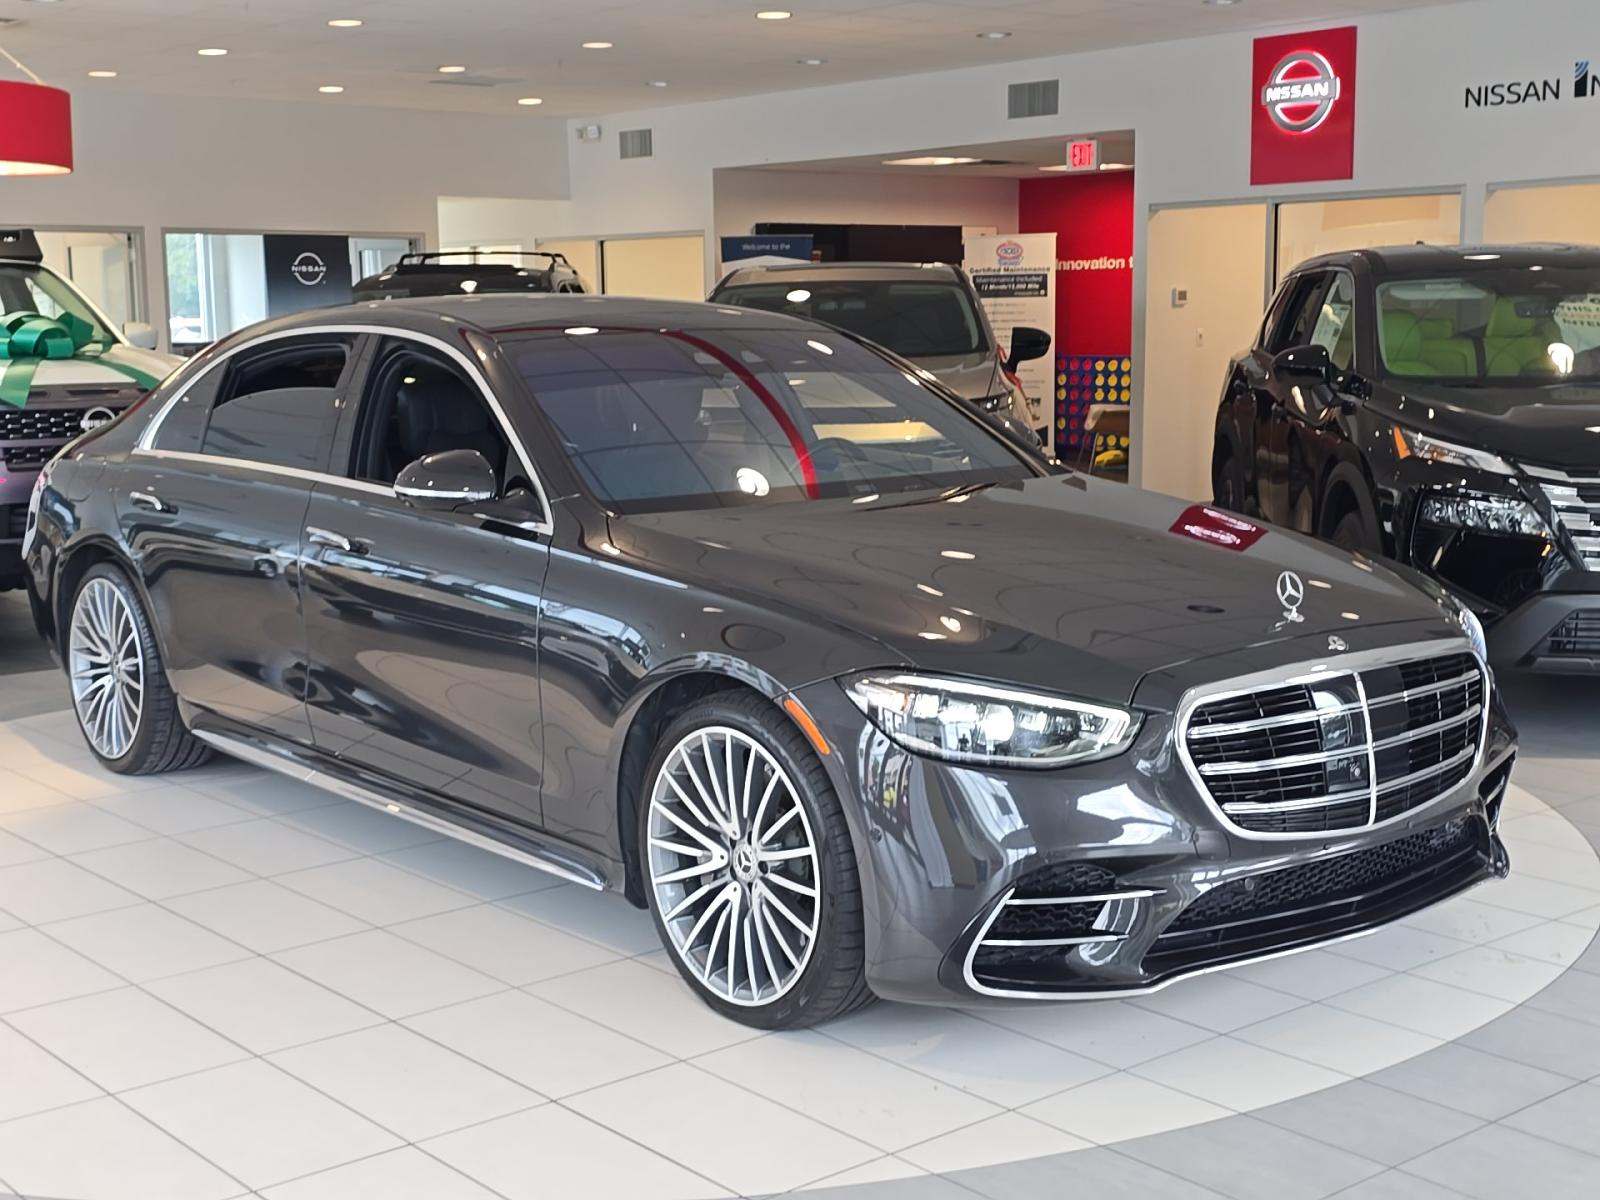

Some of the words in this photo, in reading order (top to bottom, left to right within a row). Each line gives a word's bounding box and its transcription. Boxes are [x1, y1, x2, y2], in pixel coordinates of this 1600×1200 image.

[1266, 81, 1329, 103] NISSAN
[1465, 77, 1560, 108] NISSAN
[1071, 143, 1093, 167] EXIT
[291, 265, 327, 273] NISSAN
